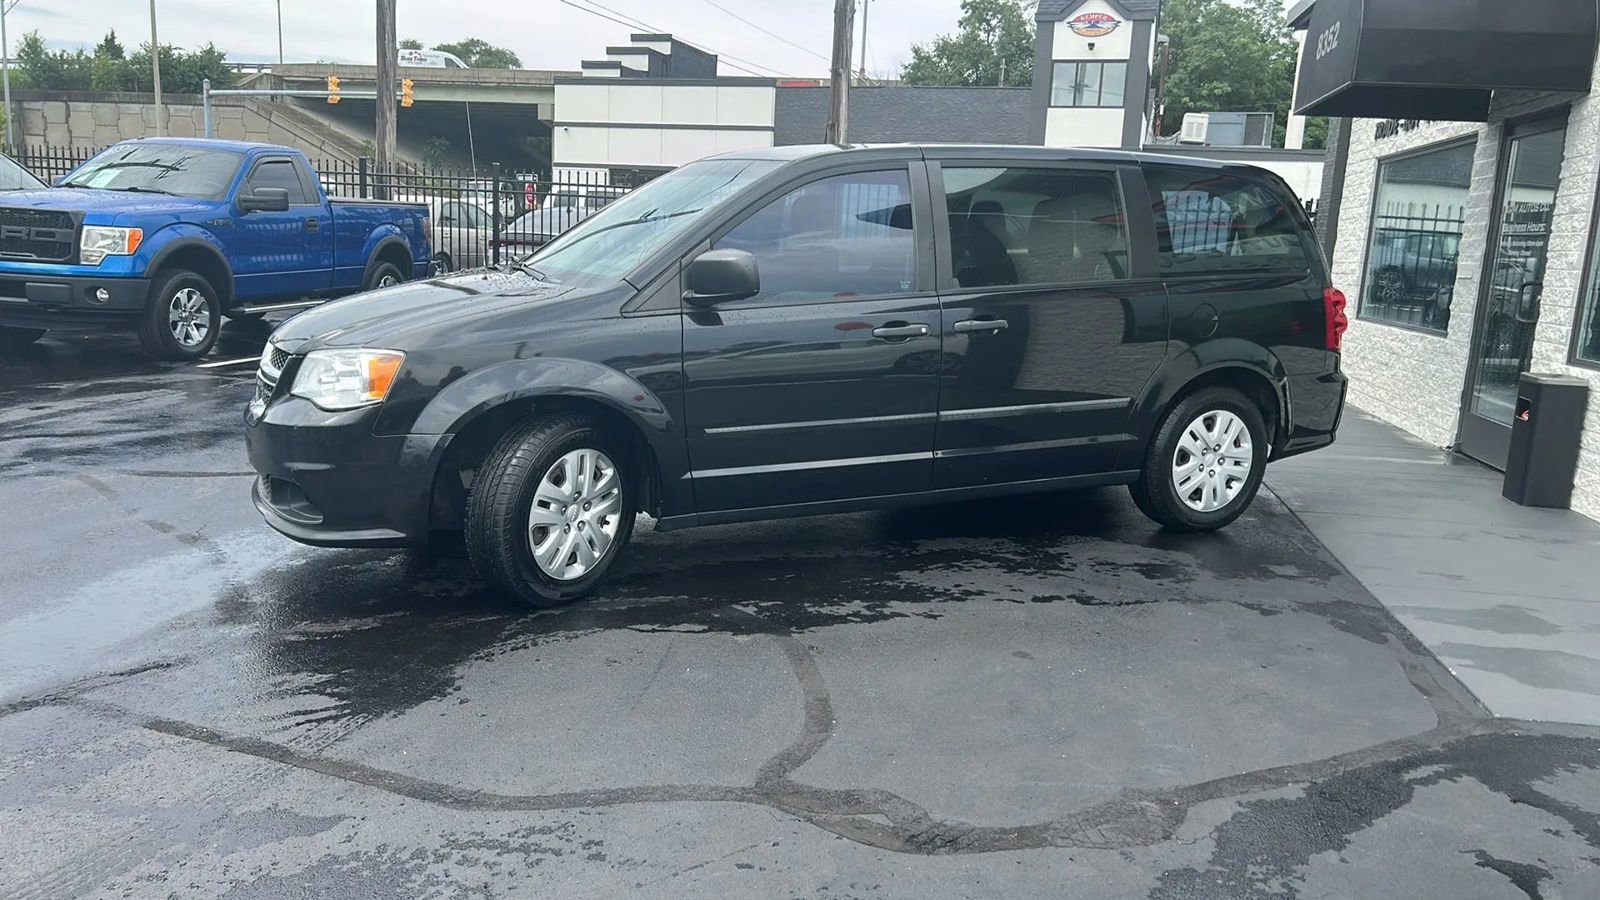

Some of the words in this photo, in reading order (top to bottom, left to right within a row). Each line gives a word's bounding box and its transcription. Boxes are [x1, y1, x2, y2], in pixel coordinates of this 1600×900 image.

[1080, 13, 1108, 21] KEMPER
[1316, 20, 1340, 60] 8352
[1519, 203, 1539, 213] AUTOS
[1503, 223, 1527, 232] Business
